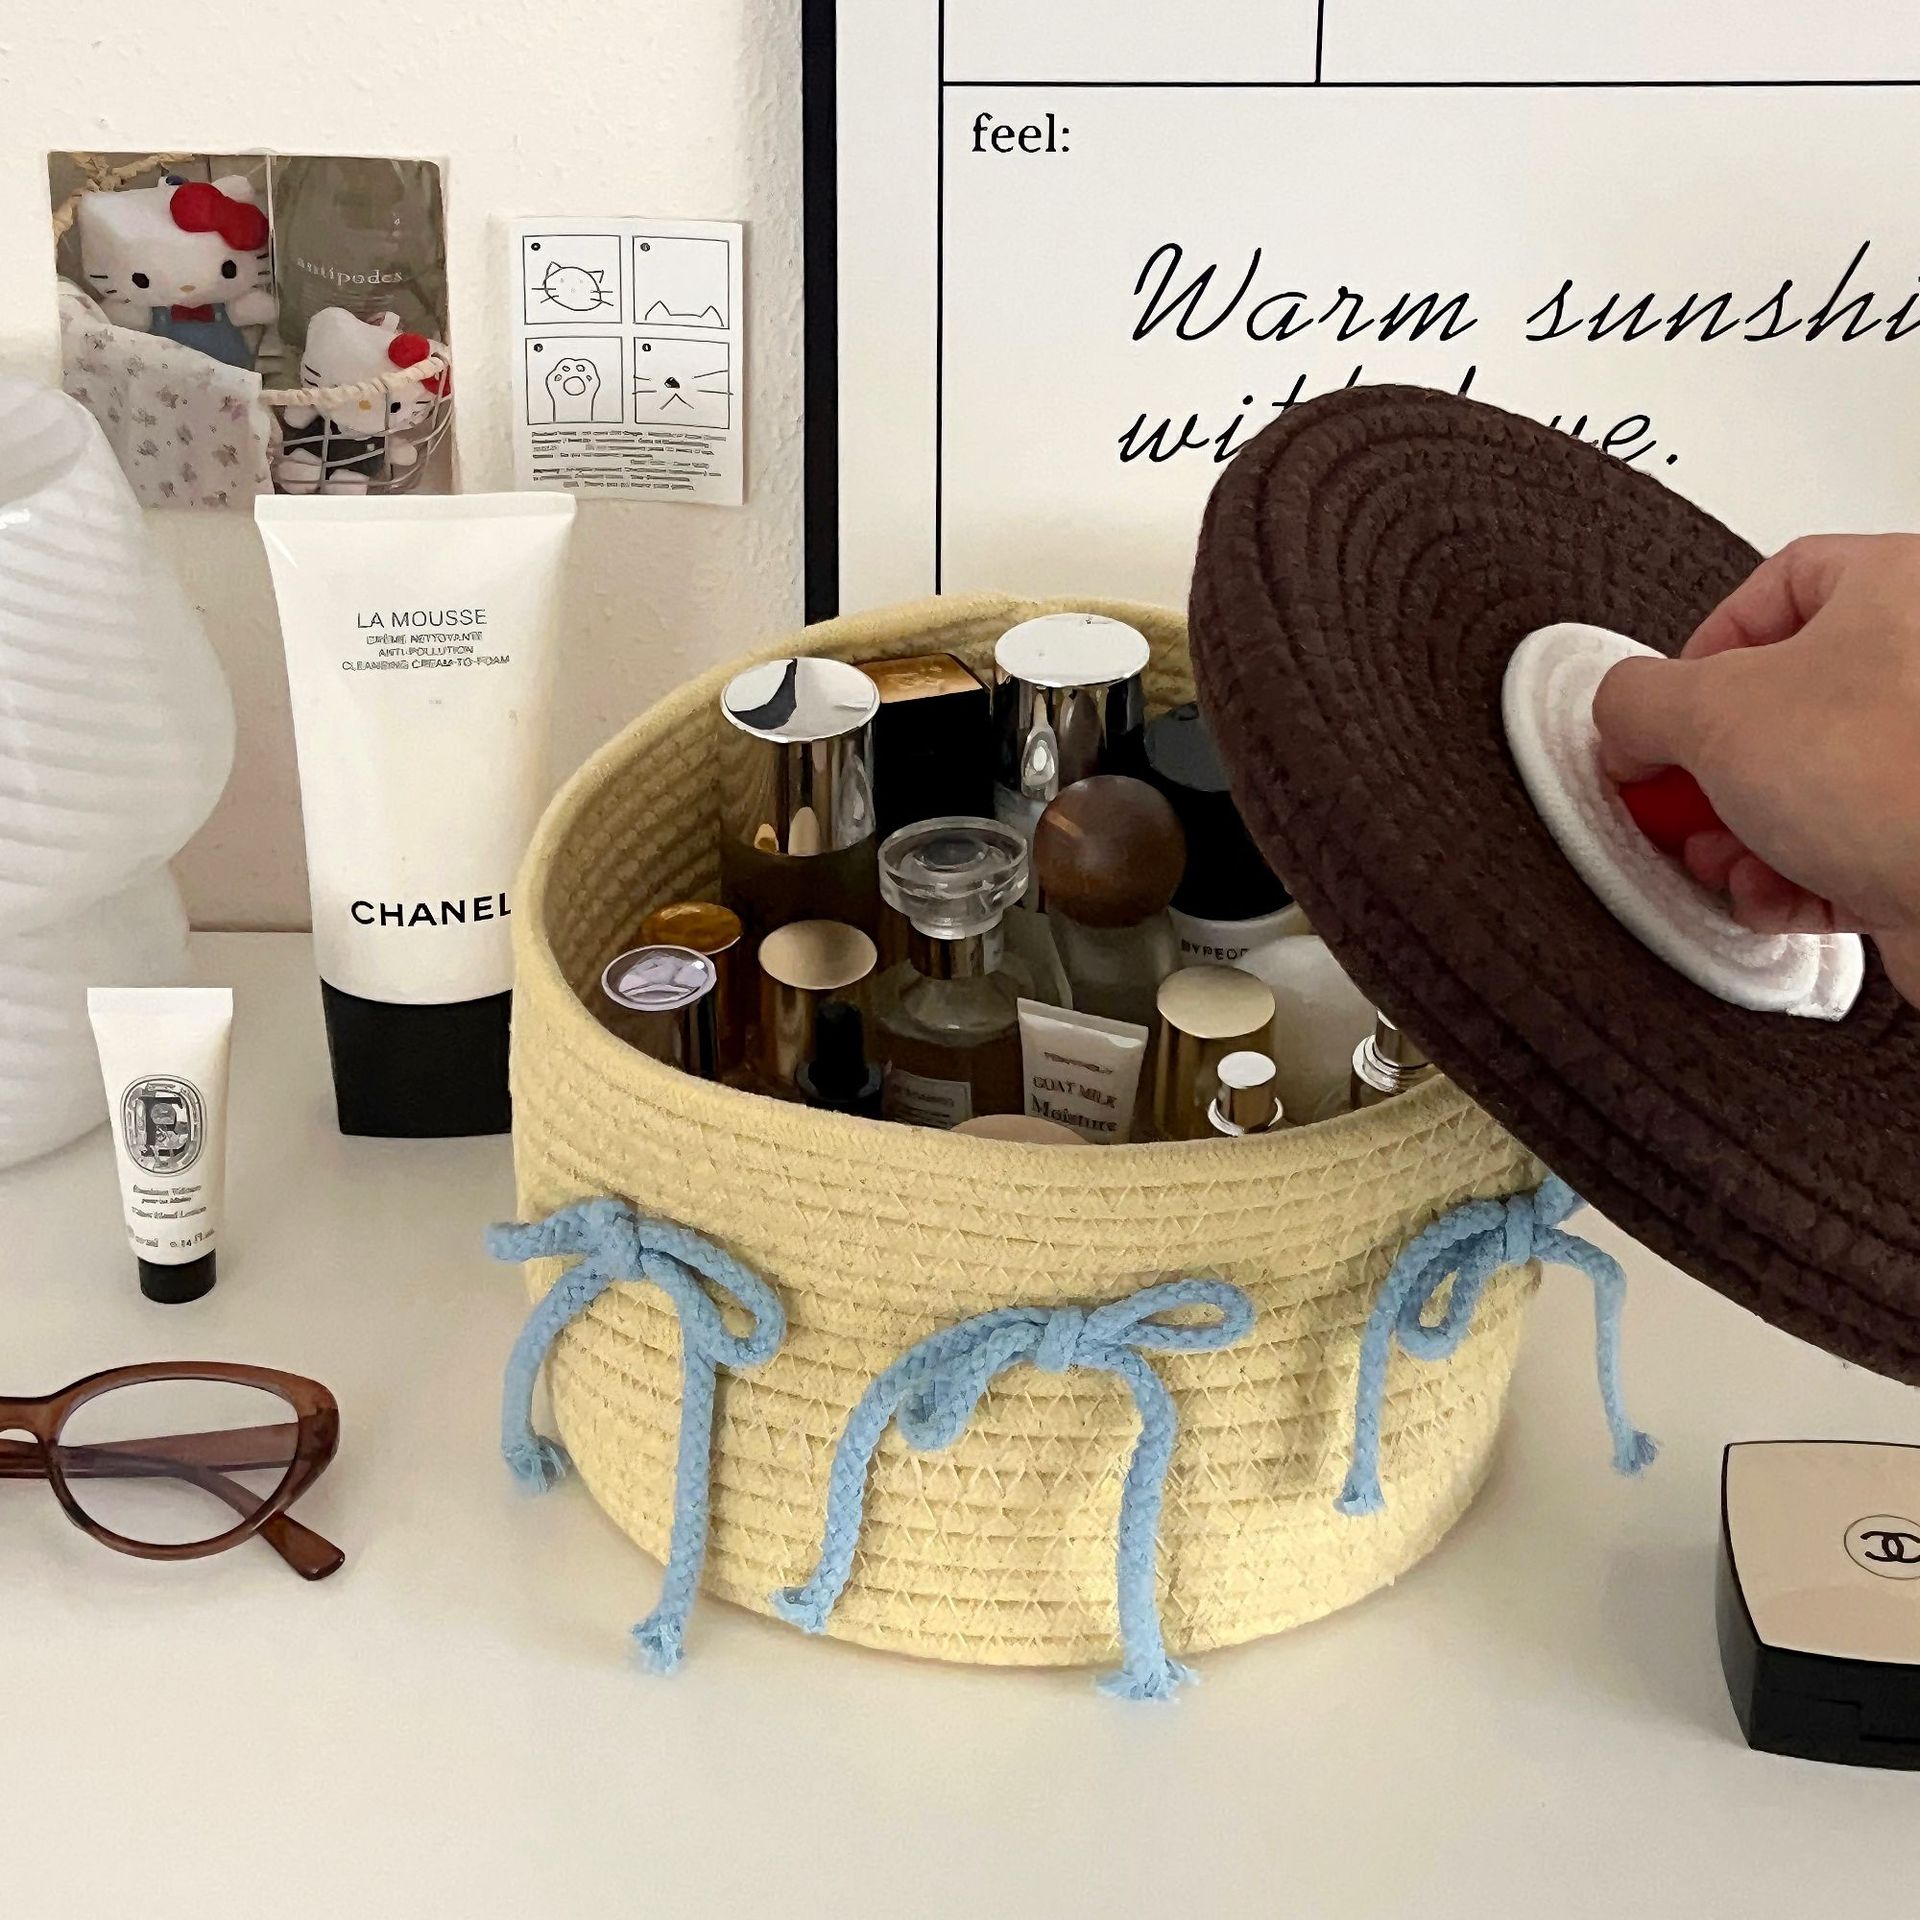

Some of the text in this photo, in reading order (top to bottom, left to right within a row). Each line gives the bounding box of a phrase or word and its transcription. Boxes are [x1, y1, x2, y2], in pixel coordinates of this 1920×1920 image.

[972, 112, 1070, 154] feel:
[1132, 242, 1478, 342] Warm
[357, 609, 488, 628] LA MOUSSE
[351, 892, 512, 927] CHANEL
